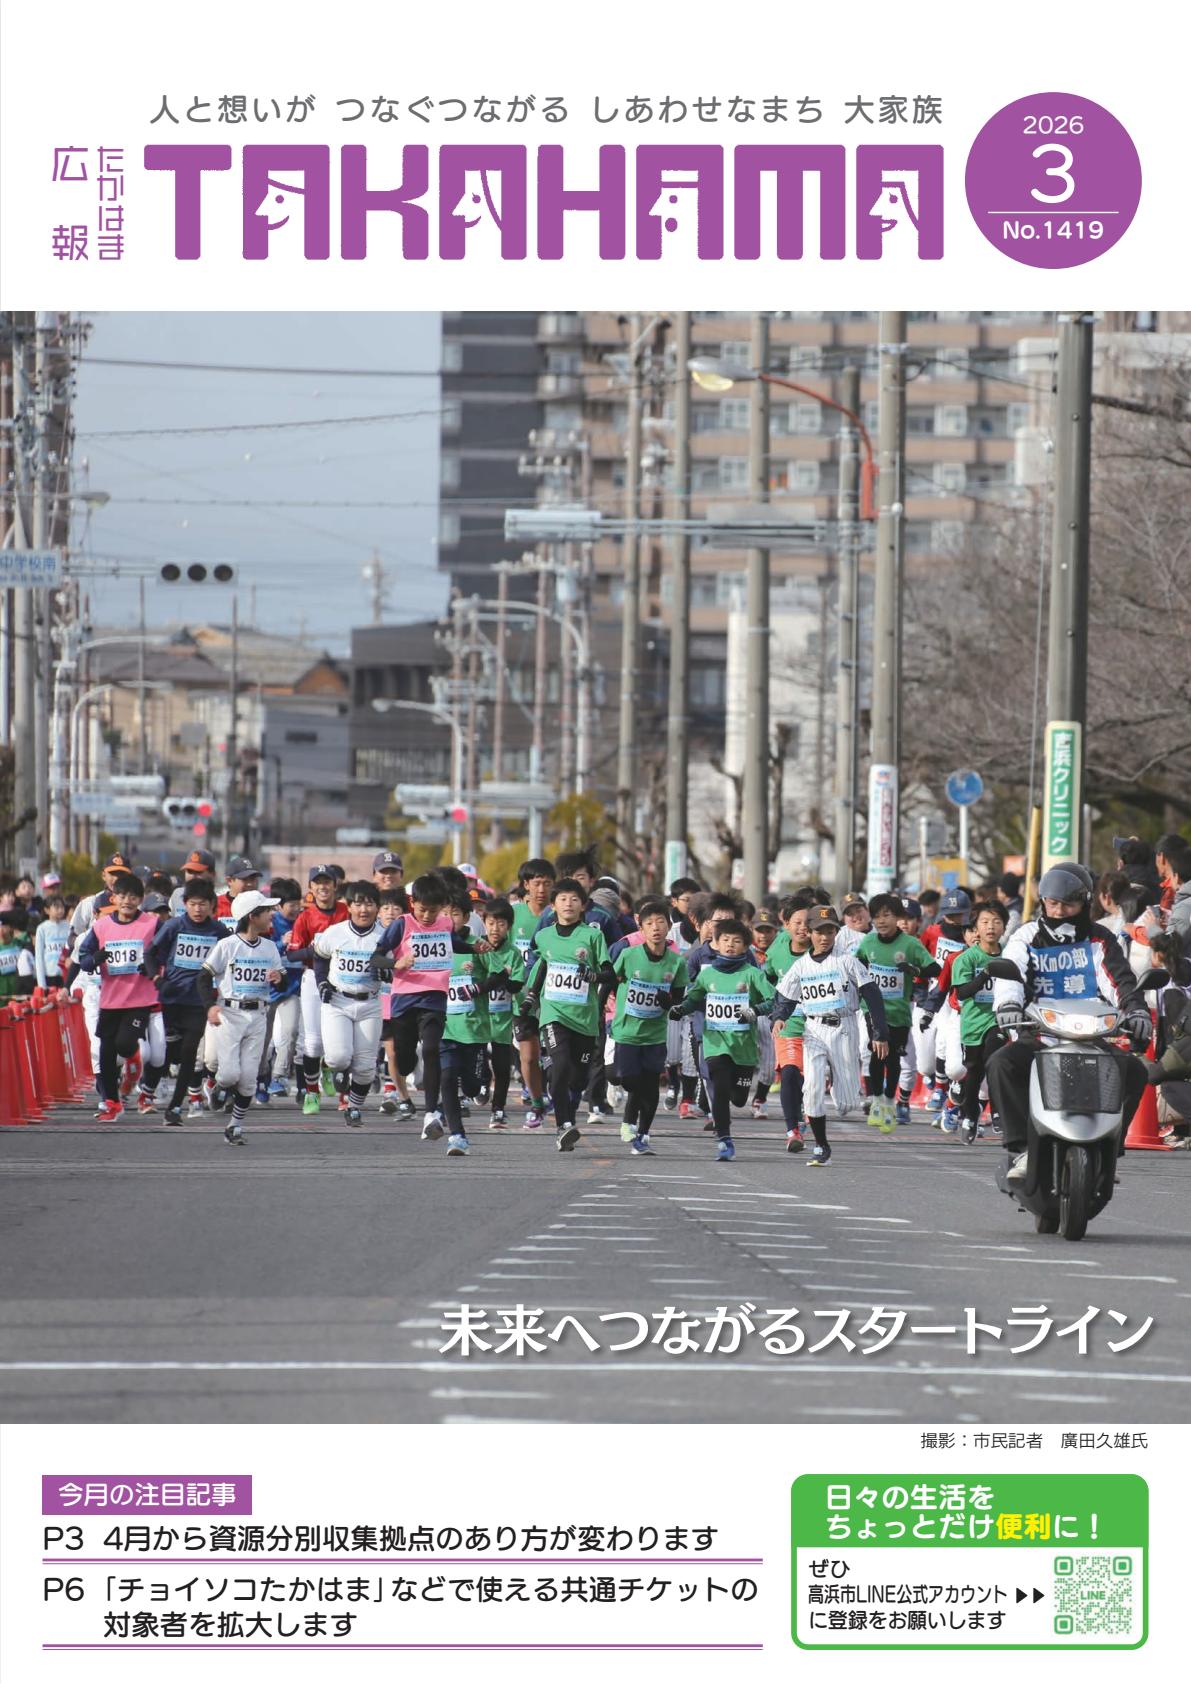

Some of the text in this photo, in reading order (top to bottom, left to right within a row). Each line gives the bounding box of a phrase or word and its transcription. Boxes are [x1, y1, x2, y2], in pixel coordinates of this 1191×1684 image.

[107, 949, 137, 964] 3018
[176, 943, 210, 959] 3017
[412, 942, 447, 958] 3043
[234, 967, 267, 982] 3025
[547, 973, 582, 990] 3040
[803, 982, 836, 1000] 3064
[707, 1003, 742, 1019] 3005
